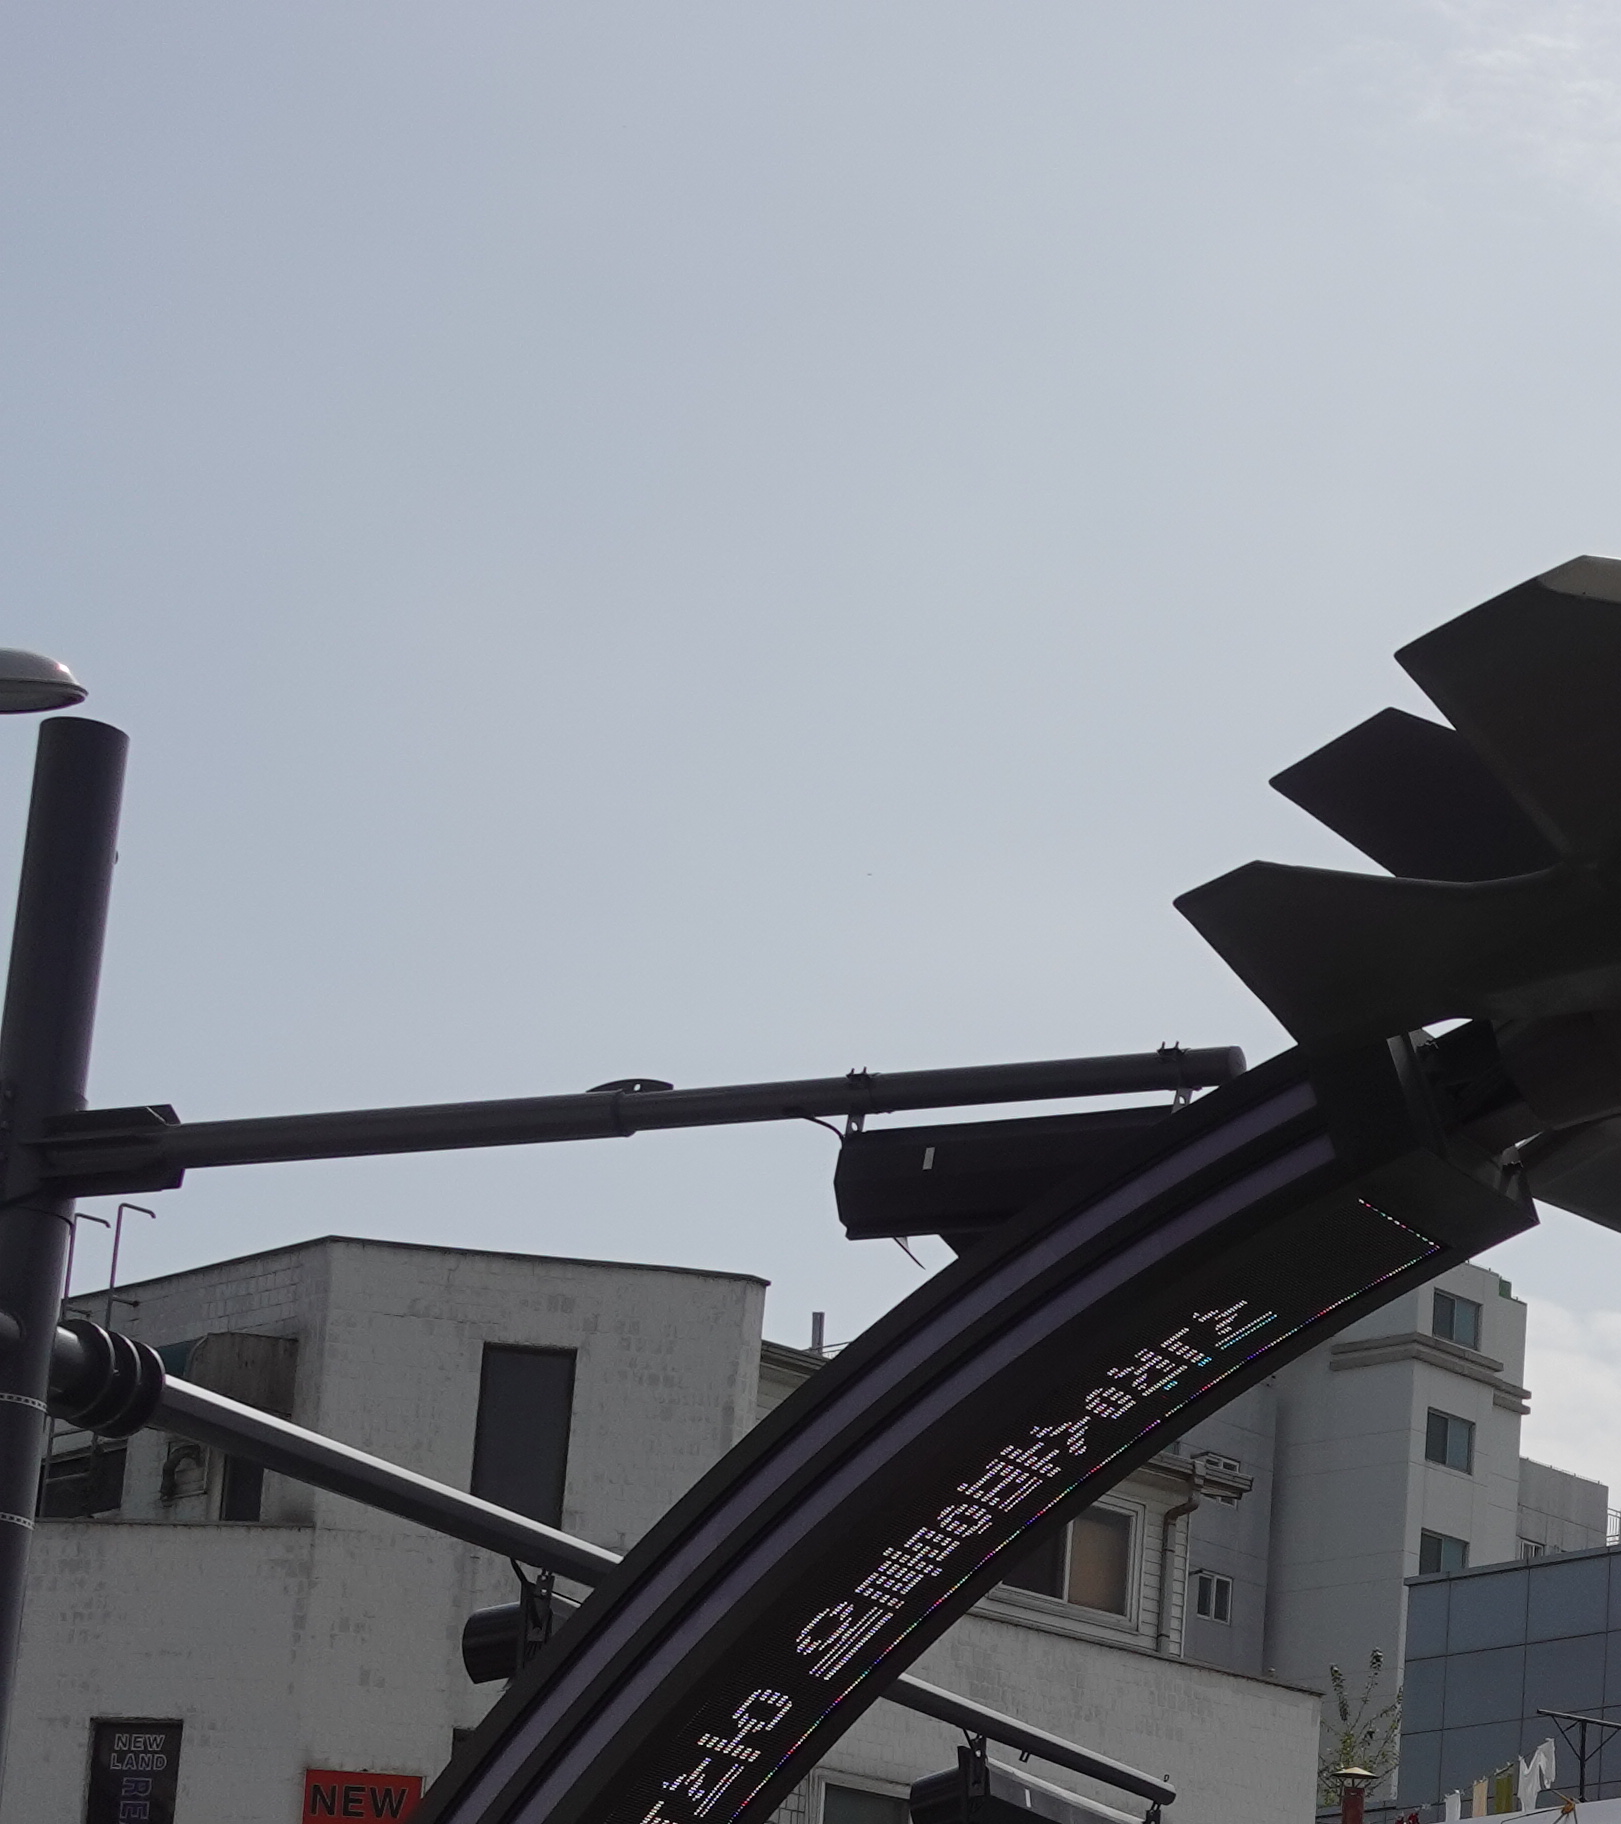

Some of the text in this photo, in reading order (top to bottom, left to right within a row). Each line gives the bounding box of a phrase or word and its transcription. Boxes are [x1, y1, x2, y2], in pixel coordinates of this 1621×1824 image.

[795, 1298, 1278, 1681] 신장쇼핑몰에
[114, 1733, 166, 1751] NEW
[110, 1753, 167, 1772] LAND
[310, 1784, 408, 1818] NEW
